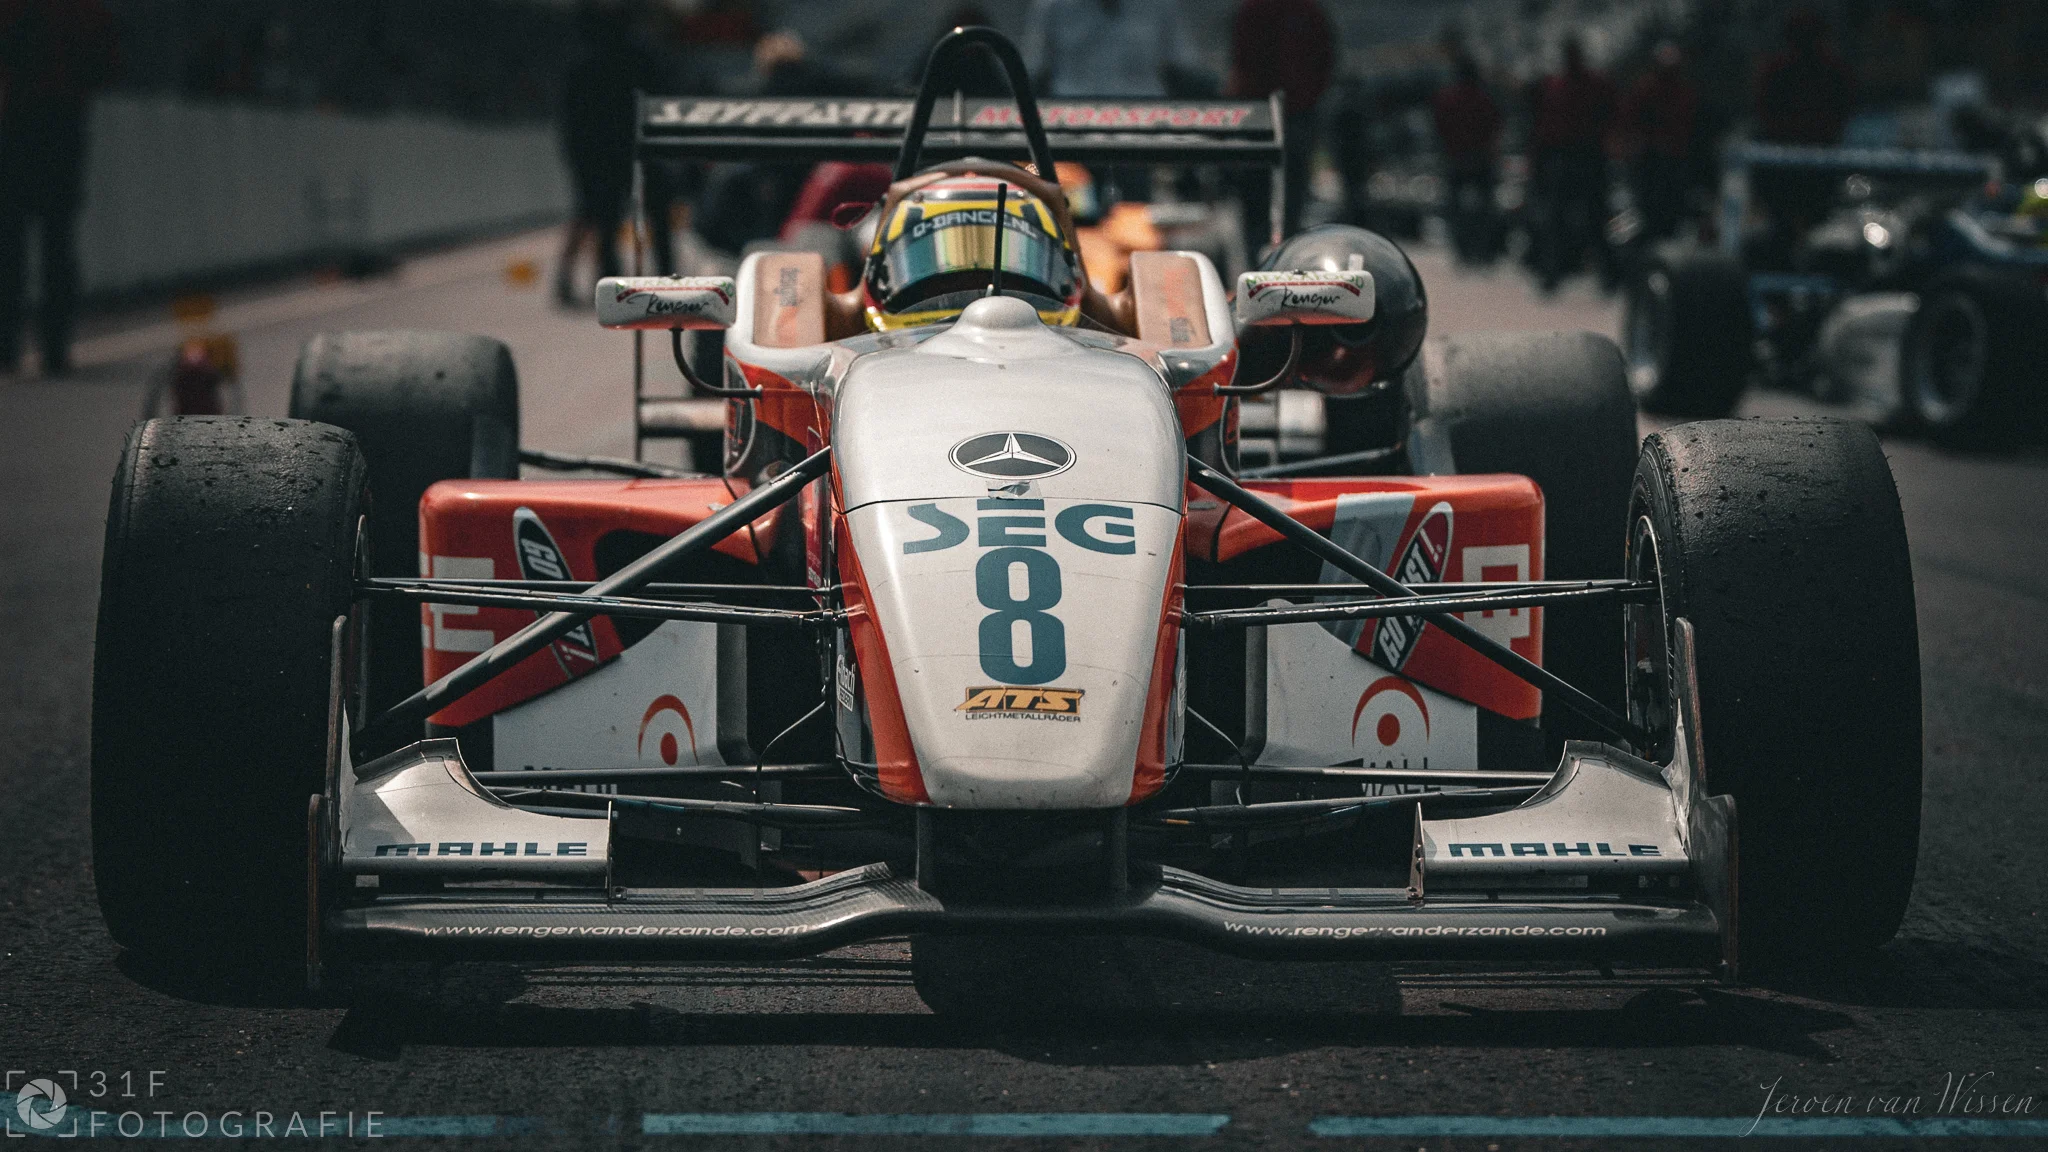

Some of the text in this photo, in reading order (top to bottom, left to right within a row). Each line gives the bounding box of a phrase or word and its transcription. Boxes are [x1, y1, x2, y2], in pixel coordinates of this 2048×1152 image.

[973, 105, 1250, 127] MTORSPORT
[903, 498, 1136, 555] SEG
[975, 546, 1067, 686] 8
[954, 687, 1084, 712] ATS
[375, 842, 588, 857] MAHLE
[1448, 842, 1663, 858] MAHLE
[424, 923, 809, 939] www.rengervanderzande.com
